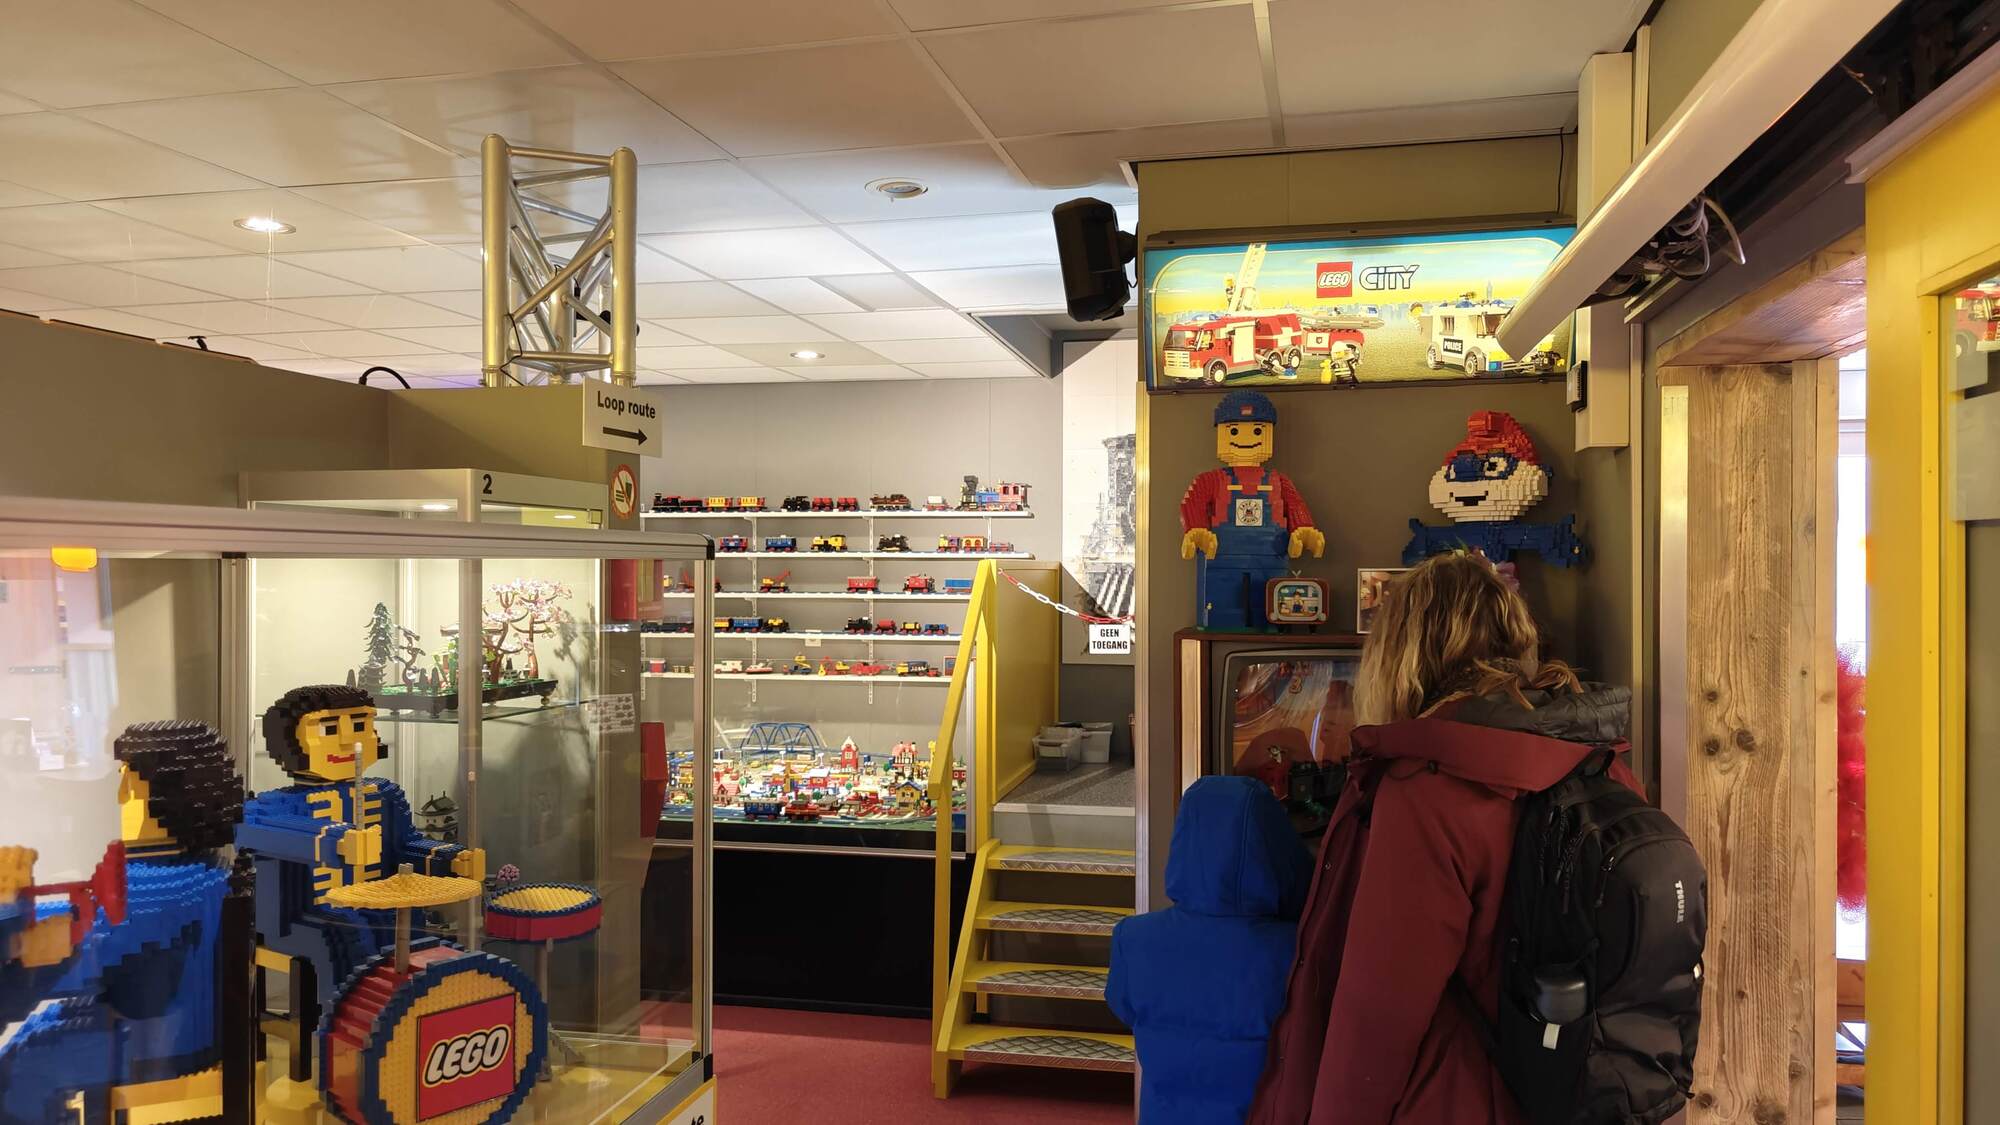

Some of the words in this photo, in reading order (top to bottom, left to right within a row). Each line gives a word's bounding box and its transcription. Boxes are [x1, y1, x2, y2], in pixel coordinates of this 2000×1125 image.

[1318, 271, 1352, 289] LEGO
[1443, 340, 1463, 352] POLICE
[597, 391, 625, 416] Loop
[628, 401, 656, 419] route
[482, 473, 493, 495] 2
[1100, 628, 1120, 638] GEEN
[1092, 640, 1128, 650] TOEGANG
[1675, 879, 1685, 923] THULE
[423, 1024, 511, 1088] LEGO
